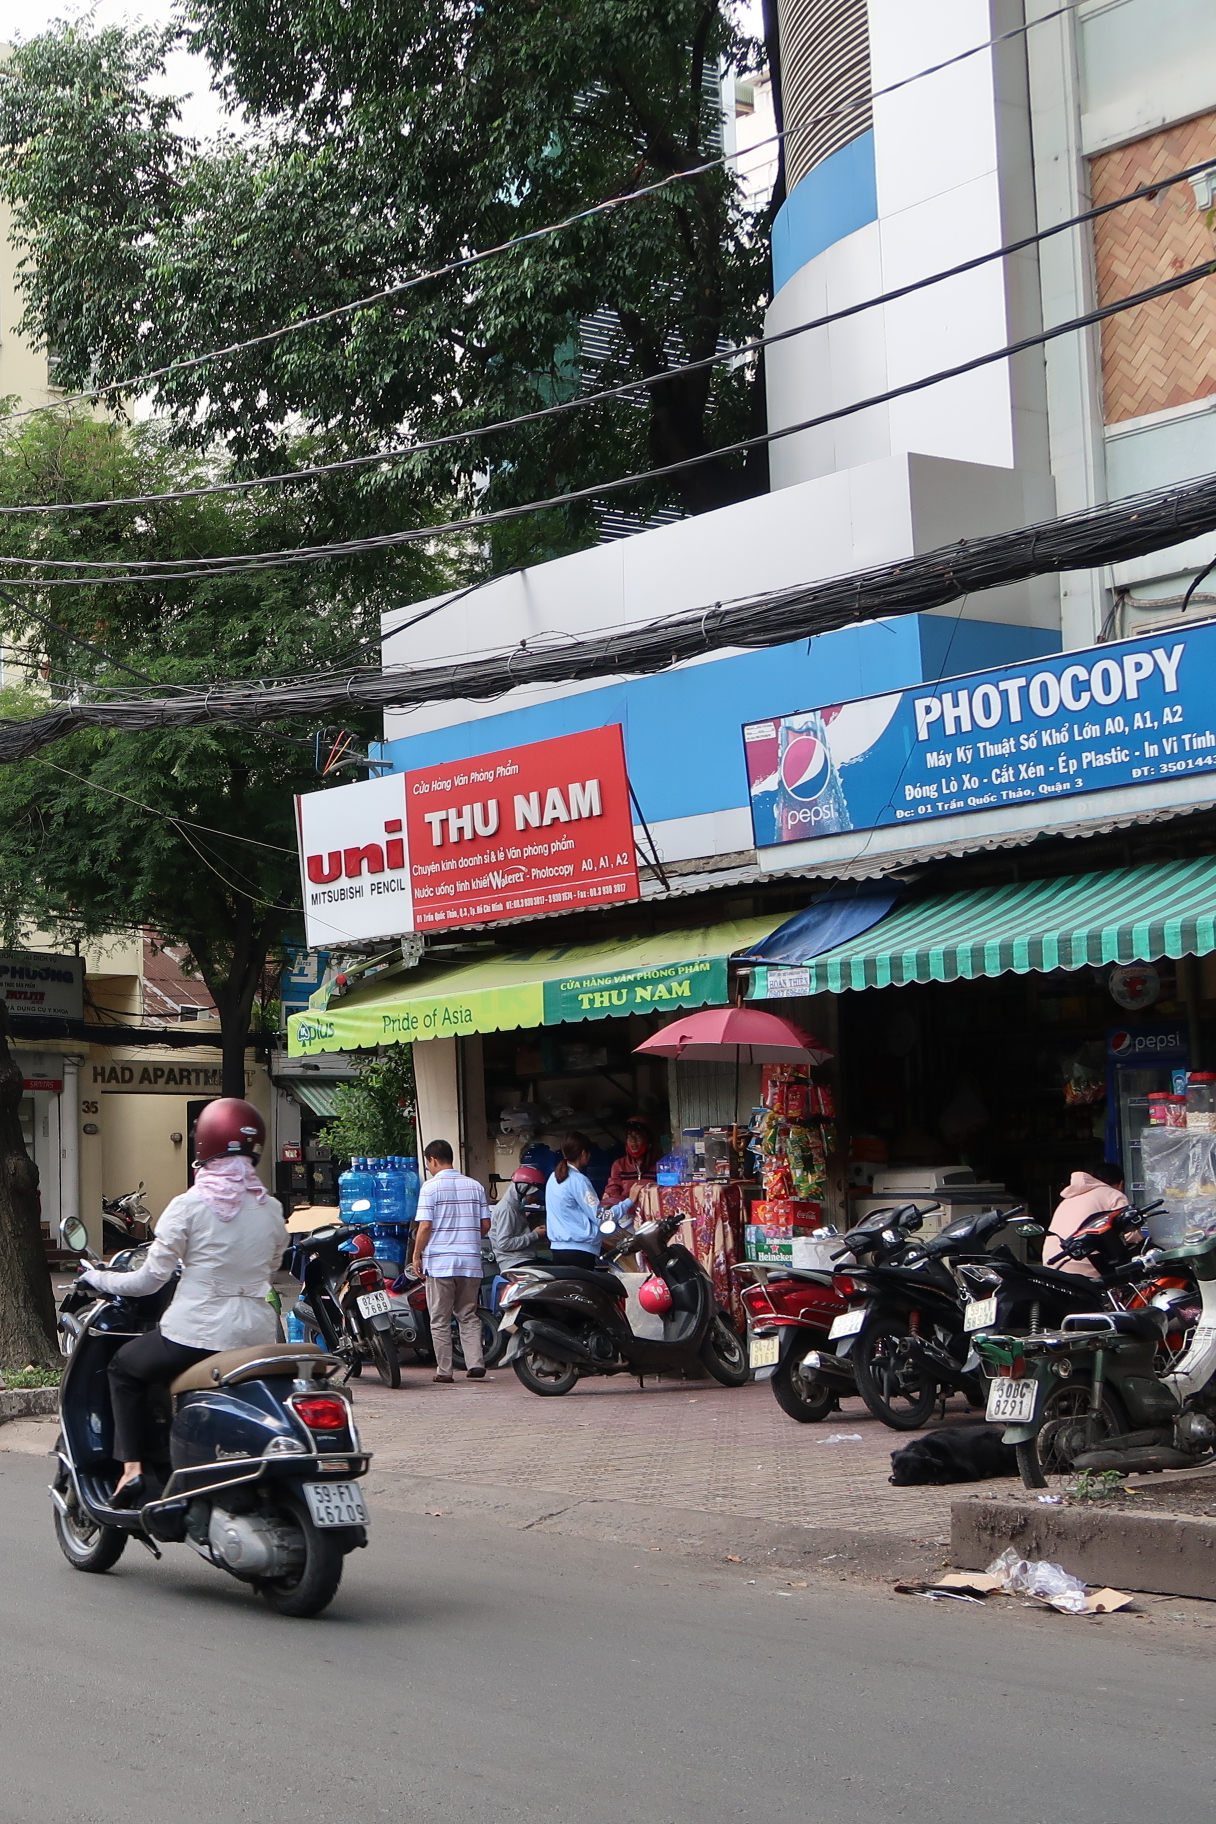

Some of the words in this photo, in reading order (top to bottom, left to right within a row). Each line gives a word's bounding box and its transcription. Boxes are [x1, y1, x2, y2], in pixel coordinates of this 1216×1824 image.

[914, 642, 1186, 741] PHOTOCOPY
[926, 749, 953, 769] Máy
[956, 745, 973, 764] Kỹ
[977, 737, 1016, 758] Thuật
[1019, 729, 1038, 750] Số
[1041, 722, 1070, 747] Khổ
[1073, 721, 1101, 741] Lớn
[1134, 710, 1158, 730] A1,
[1162, 705, 1184, 725] A2
[413, 780, 430, 795] Cửa
[431, 776, 451, 793] Hàng
[470, 768, 494, 783] Phòng
[496, 760, 519, 778] Phẩm
[904, 783, 939, 801] Đóng
[942, 776, 958, 794] Lò
[962, 773, 979, 791] Xo
[991, 764, 1015, 785] Cắt
[1018, 762, 1045, 781] Xén
[1058, 752, 1077, 775] Ép
[1081, 746, 1130, 769] Plastic
[1144, 741, 1159, 758] In
[1162, 736, 1178, 755] Vi
[1181, 730, 1216, 751] Tính
[1132, 766, 1155, 778] ĐT:
[918, 805, 933, 815] 01
[936, 800, 964, 811] Trần
[967, 792, 998, 806] Quốc
[1000, 787, 1035, 801] Thảo,
[1038, 781, 1071, 795] Quận
[1074, 778, 1084, 788] 3
[424, 798, 500, 846] THU
[513, 779, 603, 831] NAM
[787, 804, 835, 830] pepsi
[307, 819, 405, 884] uni
[412, 861, 440, 877] Chuyên
[441, 858, 457, 871] kinh
[458, 853, 483, 868] doanh
[490, 851, 496, 863] &
[524, 842, 549, 859] phòng
[551, 834, 575, 853] phẩm
[414, 884, 434, 899] Nước
[435, 882, 455, 896] uống
[456, 880, 471, 892] tinh
[471, 873, 490, 889] khiết
[531, 863, 574, 880] Photocopy
[616, 853, 629, 866] A2
[311, 884, 364, 906] MITSUBISHI
[370, 878, 406, 896] PENCIL
[560, 978, 581, 991] CỬA
[583, 974, 612, 987] HÀNG
[636, 967, 676, 981] PHÒNG
[678, 960, 711, 974] PHẨM
[578, 989, 628, 1010] THU
[635, 980, 692, 1003] NAM
[382, 1011, 419, 1034] Pride
[423, 1010, 437, 1029] of
[441, 1003, 473, 1026] Asia
[1135, 1030, 1180, 1052] pepsi
[30, 1080, 54, 1089] SANITAS
[93, 1066, 133, 1084] HAD
[138, 1067, 256, 1087] APARTMT
[82, 1101, 99, 1115] 35
[754, 1352, 775, 1366] 9163
[994, 1399, 1024, 1416] 8291
[313, 1484, 355, 1503] 59-F1
